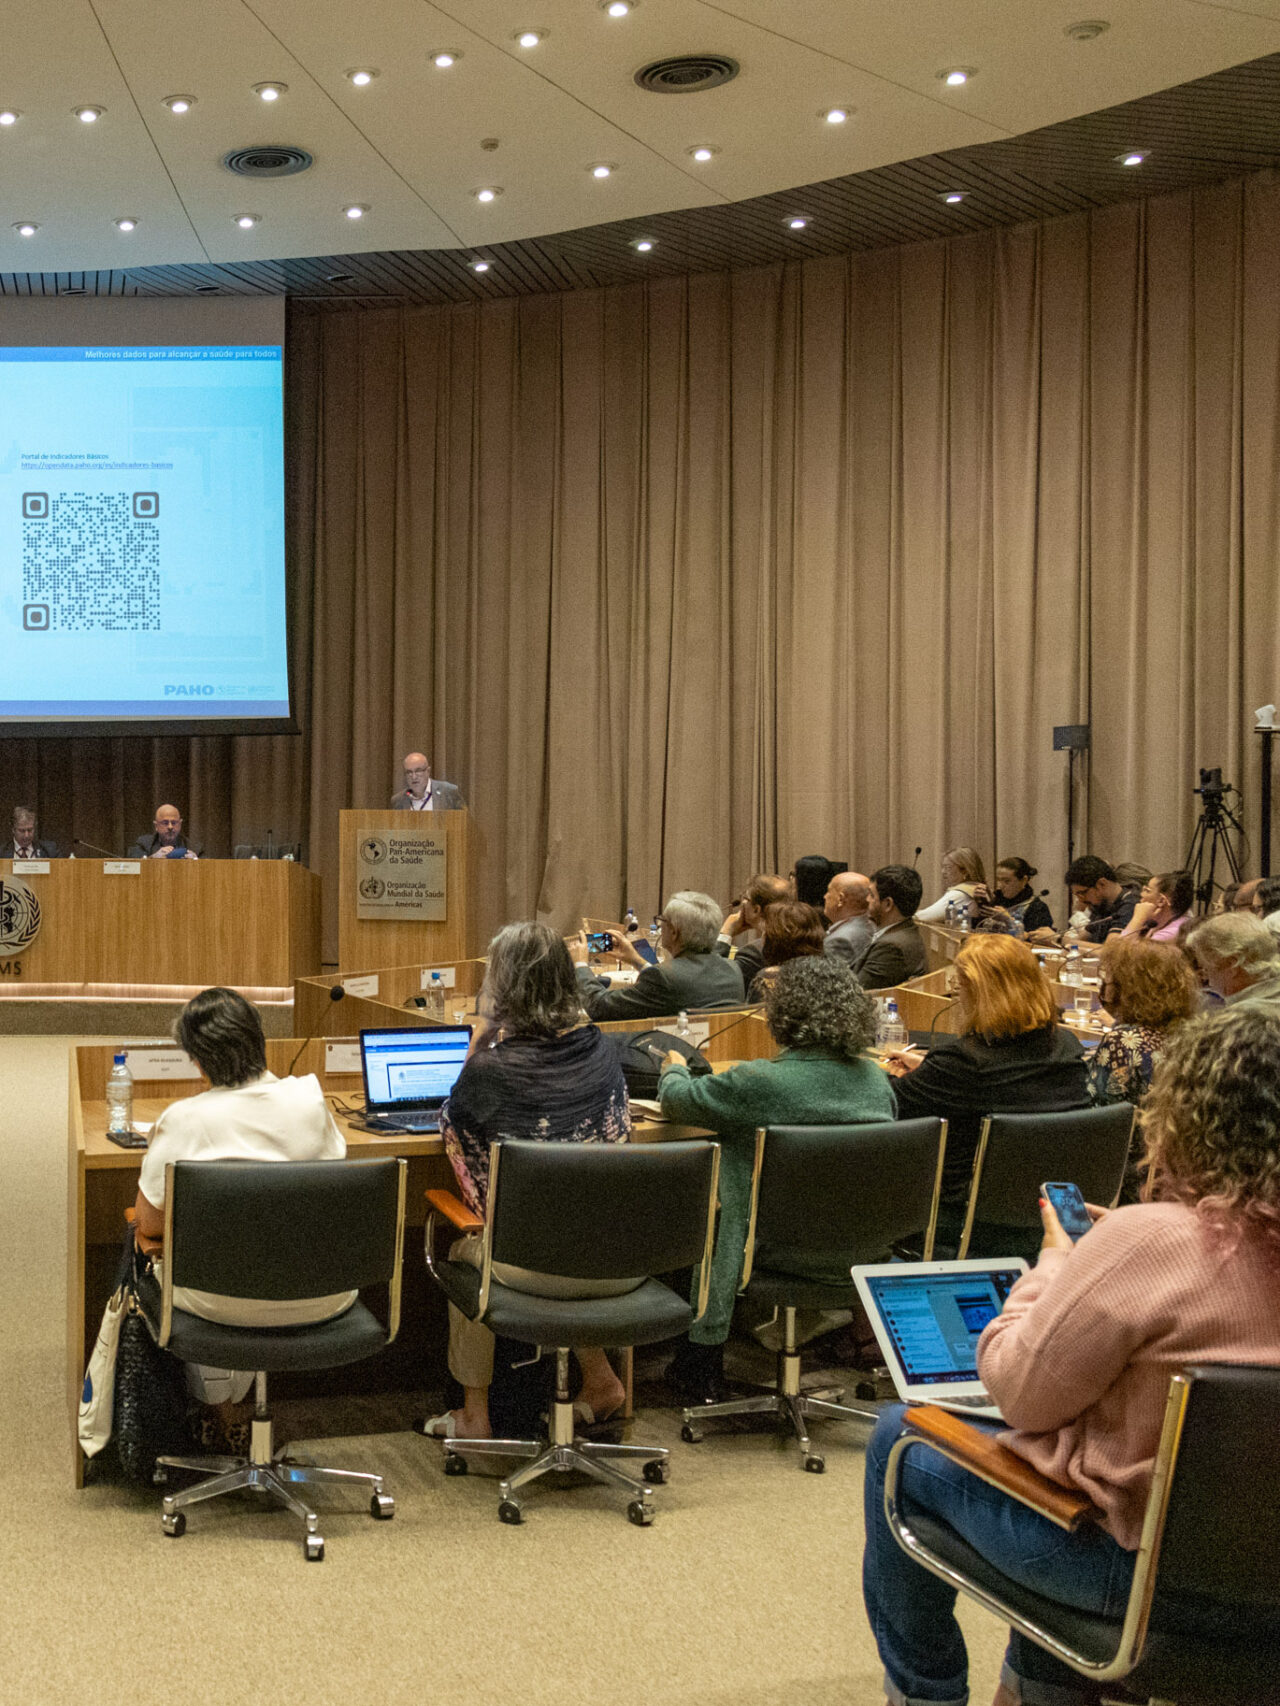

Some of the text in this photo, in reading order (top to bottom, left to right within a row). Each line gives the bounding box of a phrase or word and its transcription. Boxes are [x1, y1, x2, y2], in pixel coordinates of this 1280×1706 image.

[85, 350, 121, 359] Melhores
[123, 350, 147, 359] dados
[149, 352, 167, 360] para
[168, 350, 201, 360] alcançar
[210, 350, 233, 358] saúde
[235, 351, 253, 359] para
[254, 350, 277, 358] todos
[163, 684, 215, 696] PAHO
[389, 839, 435, 850] Organização
[389, 848, 444, 856] Pan-Americana
[389, 856, 424, 864] da Saúde
[387, 882, 426, 890] Organização
[387, 890, 444, 898] Mundial da Saúde
